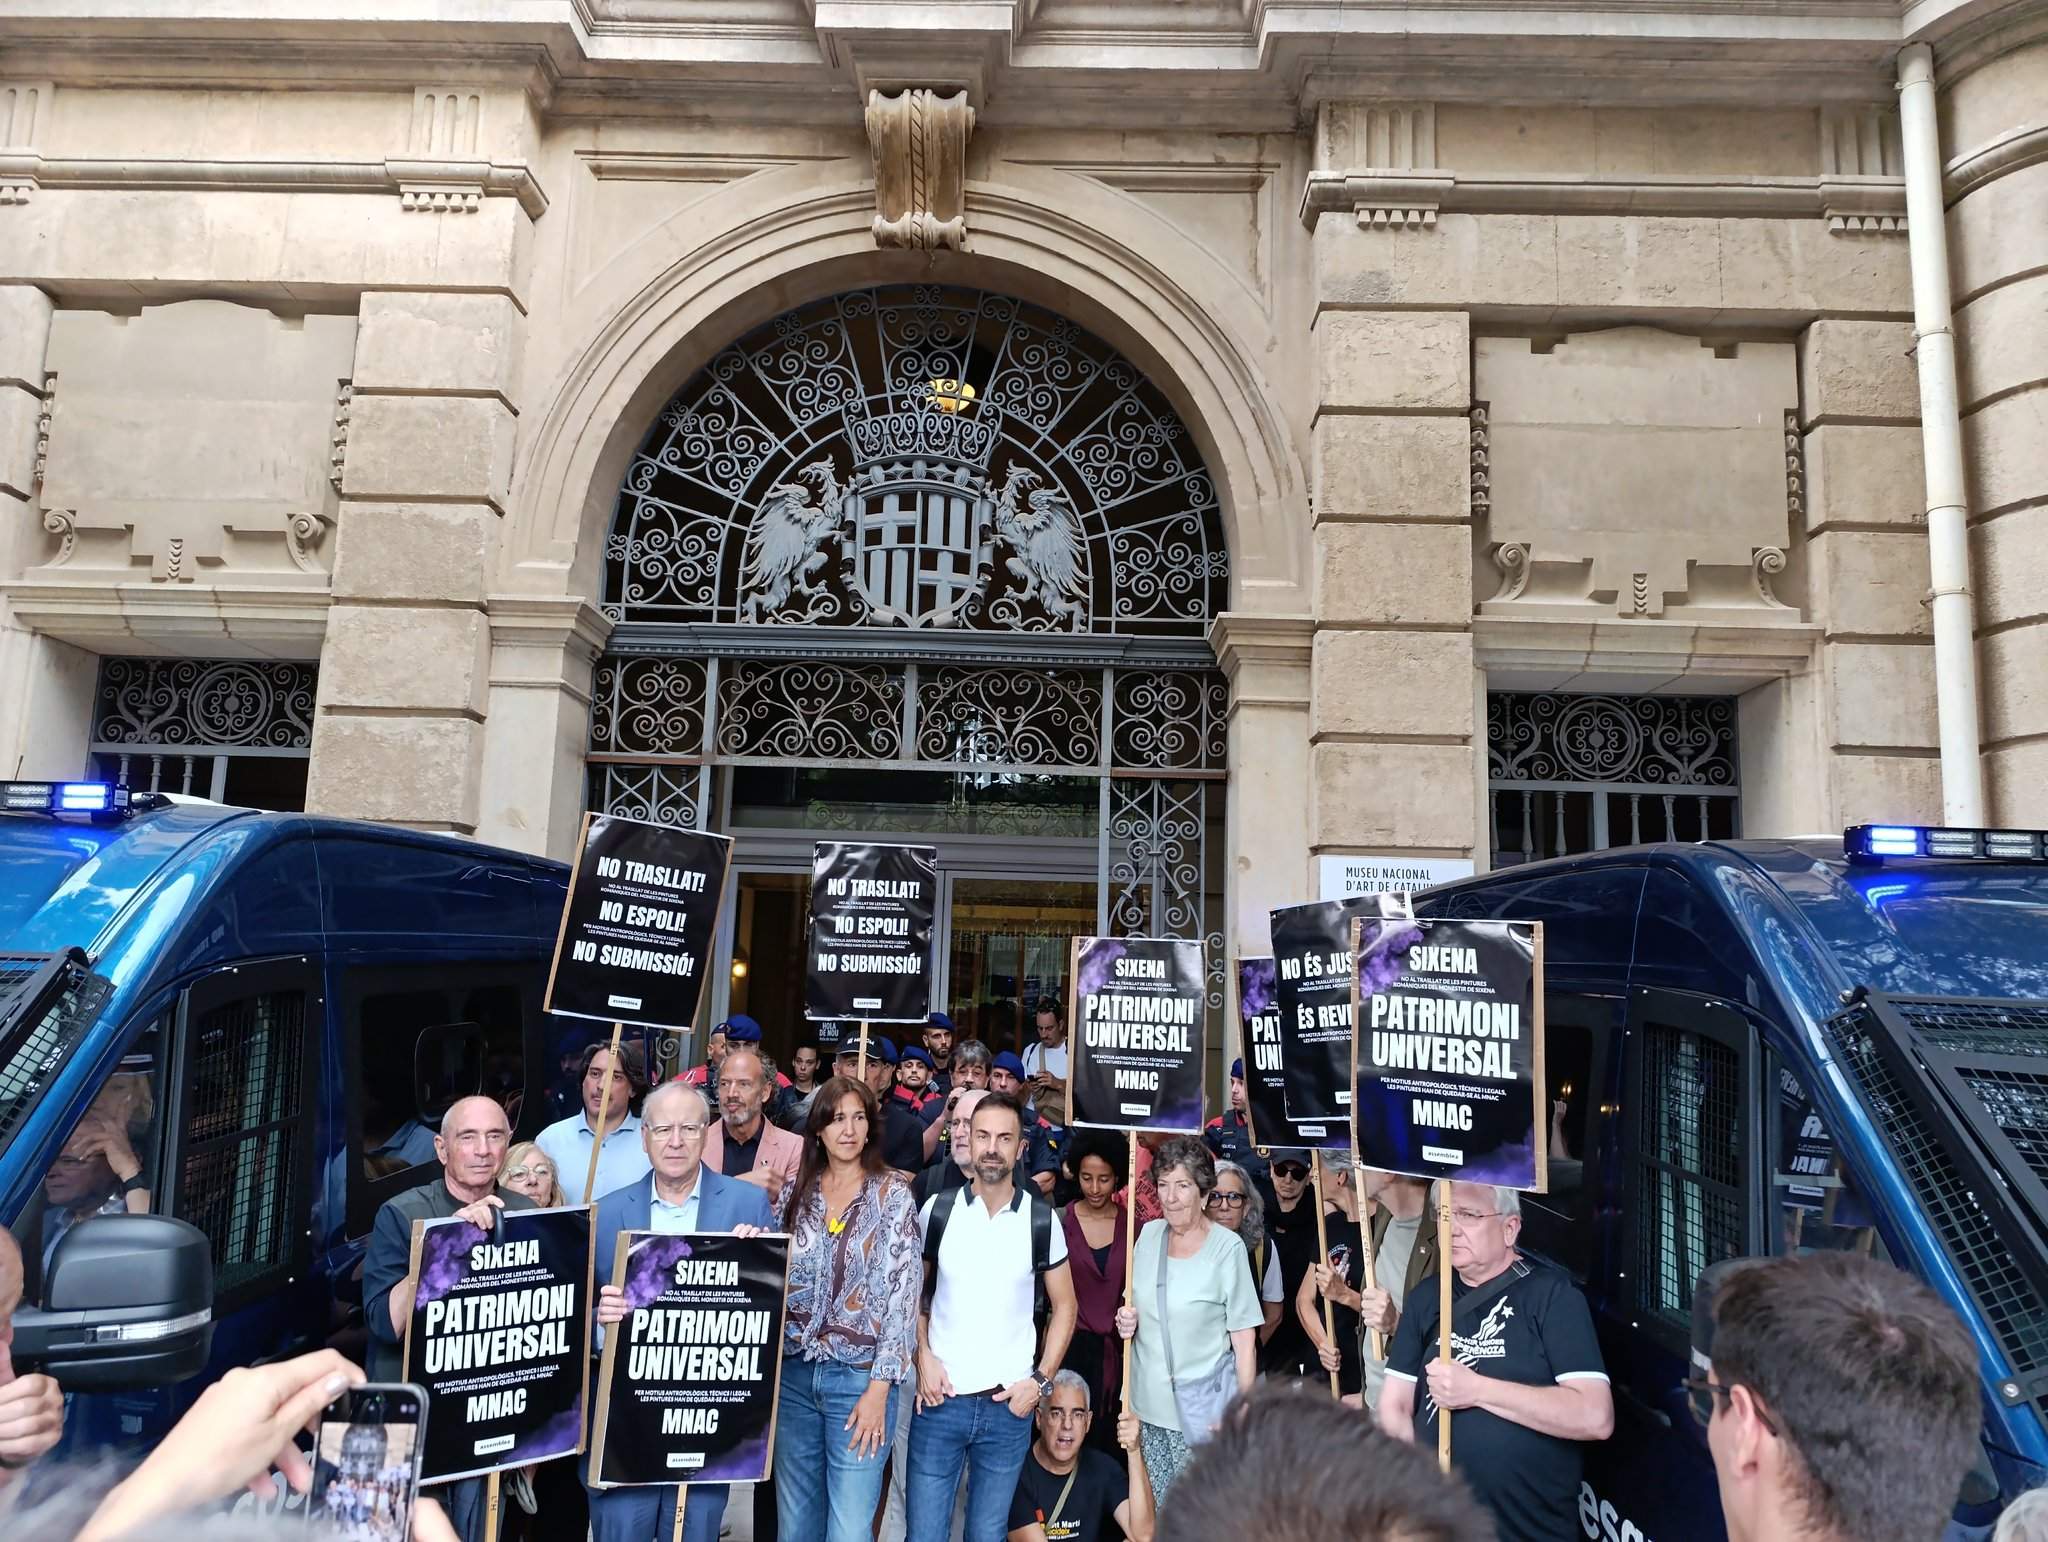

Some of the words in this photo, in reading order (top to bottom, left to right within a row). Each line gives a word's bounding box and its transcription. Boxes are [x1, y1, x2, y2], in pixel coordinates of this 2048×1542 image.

[597, 856, 620, 878] NO
[625, 861, 706, 892] TRASLLAT!
[1346, 867, 1378, 878] MUSEU
[1383, 868, 1430, 880] NACIONAL
[1346, 881, 1373, 892] D'ART
[1378, 882, 1390, 892] DE
[828, 879, 846, 896] NO
[851, 879, 920, 898] TRASLLAT!
[599, 901, 623, 922] NO
[626, 905, 686, 932] ESPOLI!
[835, 916, 854, 934] NO
[858, 917, 909, 935] ESPOLI!
[573, 940, 597, 962] NO
[600, 944, 694, 976] SUBMISSIÓ!
[818, 954, 837, 972] NO
[841, 953, 921, 974] SUBMISSIÓ!
[1116, 958, 1165, 978] SIXENA
[1282, 957, 1301, 980] NO
[1304, 951, 1322, 978] ÉS
[1409, 946, 1478, 974] SIXENA
[1086, 994, 1194, 1024] PATRIMONI
[1298, 1002, 1314, 1029] ÉS
[1372, 994, 1519, 1040] PATRIMONI
[1086, 1022, 1192, 1052] UNIVERSAL
[1372, 1031, 1517, 1080] UNIVERSAL
[1115, 1070, 1159, 1091] MNAC
[1396, 1084, 1421, 1092] PINTURES
[1442, 1089, 1473, 1098] QUEDAR-SE
[1413, 1099, 1472, 1131] MNAC
[471, 1240, 539, 1271] SIXENA
[675, 1260, 738, 1286] SIXENA
[426, 1284, 574, 1336] PATRIMONI
[631, 1309, 770, 1344] PATRIMONI
[425, 1321, 570, 1374] UNIVERSAL
[628, 1346, 762, 1380] UNIVERSAL
[444, 1379, 467, 1387] MOTIUS
[450, 1383, 478, 1392] PINTURES
[498, 1376, 528, 1385] QUEDAR-SE
[466, 1388, 527, 1423] MNAC
[662, 1408, 719, 1434] MNAC
